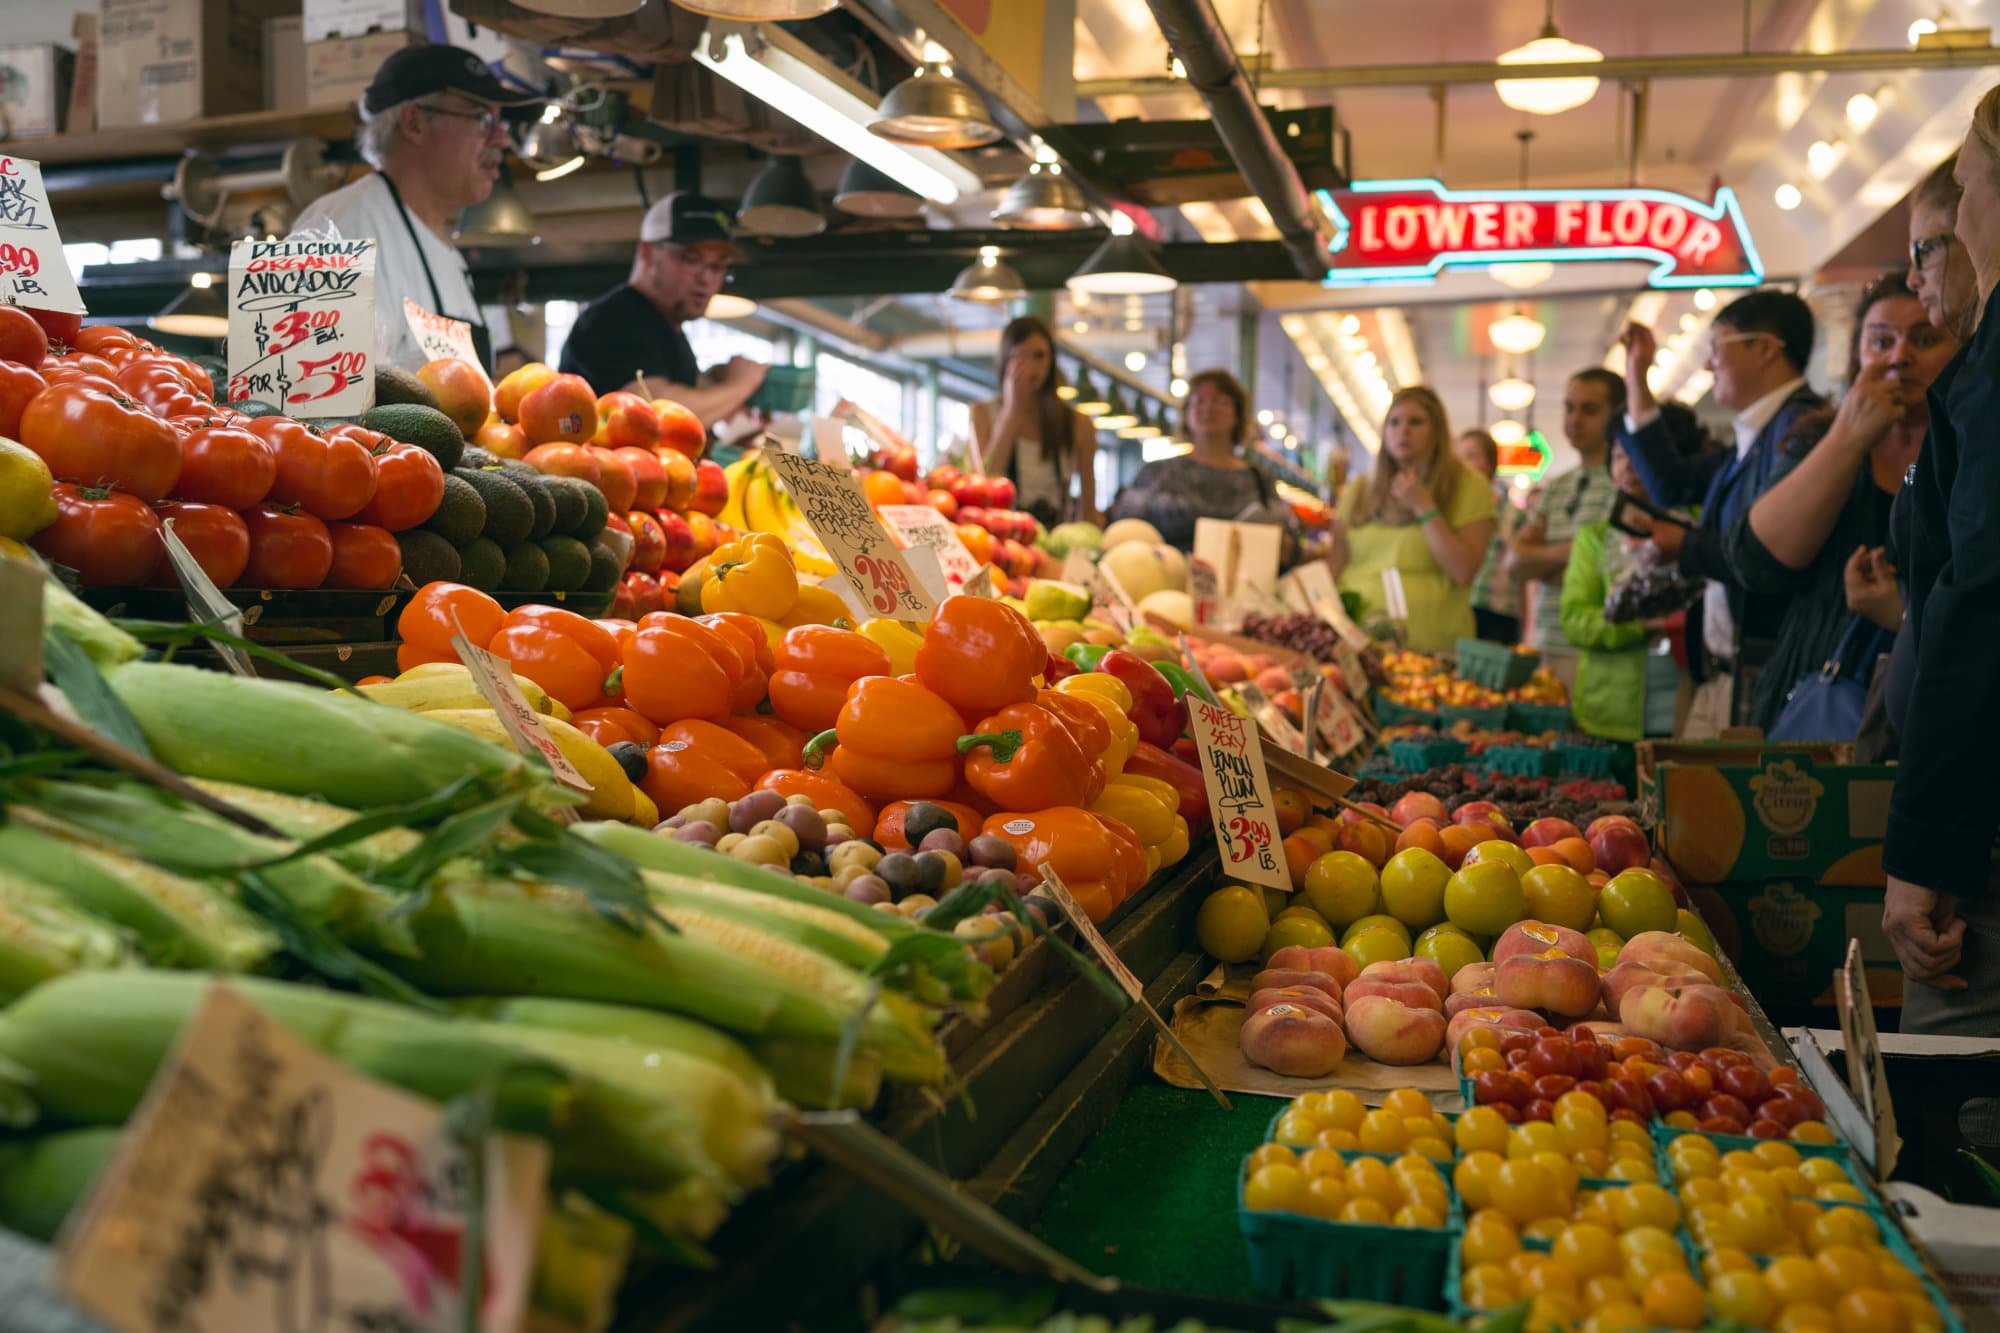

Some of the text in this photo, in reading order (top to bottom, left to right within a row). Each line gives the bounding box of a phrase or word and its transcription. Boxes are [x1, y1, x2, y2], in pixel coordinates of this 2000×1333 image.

[1360, 199, 1721, 266] LOWER FLOOR
[246, 255, 363, 273] ORGANIC
[251, 240, 370, 259] DELICIOUS
[12, 279, 48, 296] LB.
[237, 268, 361, 298] AVOCADOS
[248, 373, 274, 395] FOR
[1198, 704, 1247, 733] SWEET
[1210, 727, 1246, 759] SEXY
[1208, 745, 1253, 779] LEMON
[1216, 769, 1256, 800] PLUM
[1258, 852, 1280, 874] LB.
